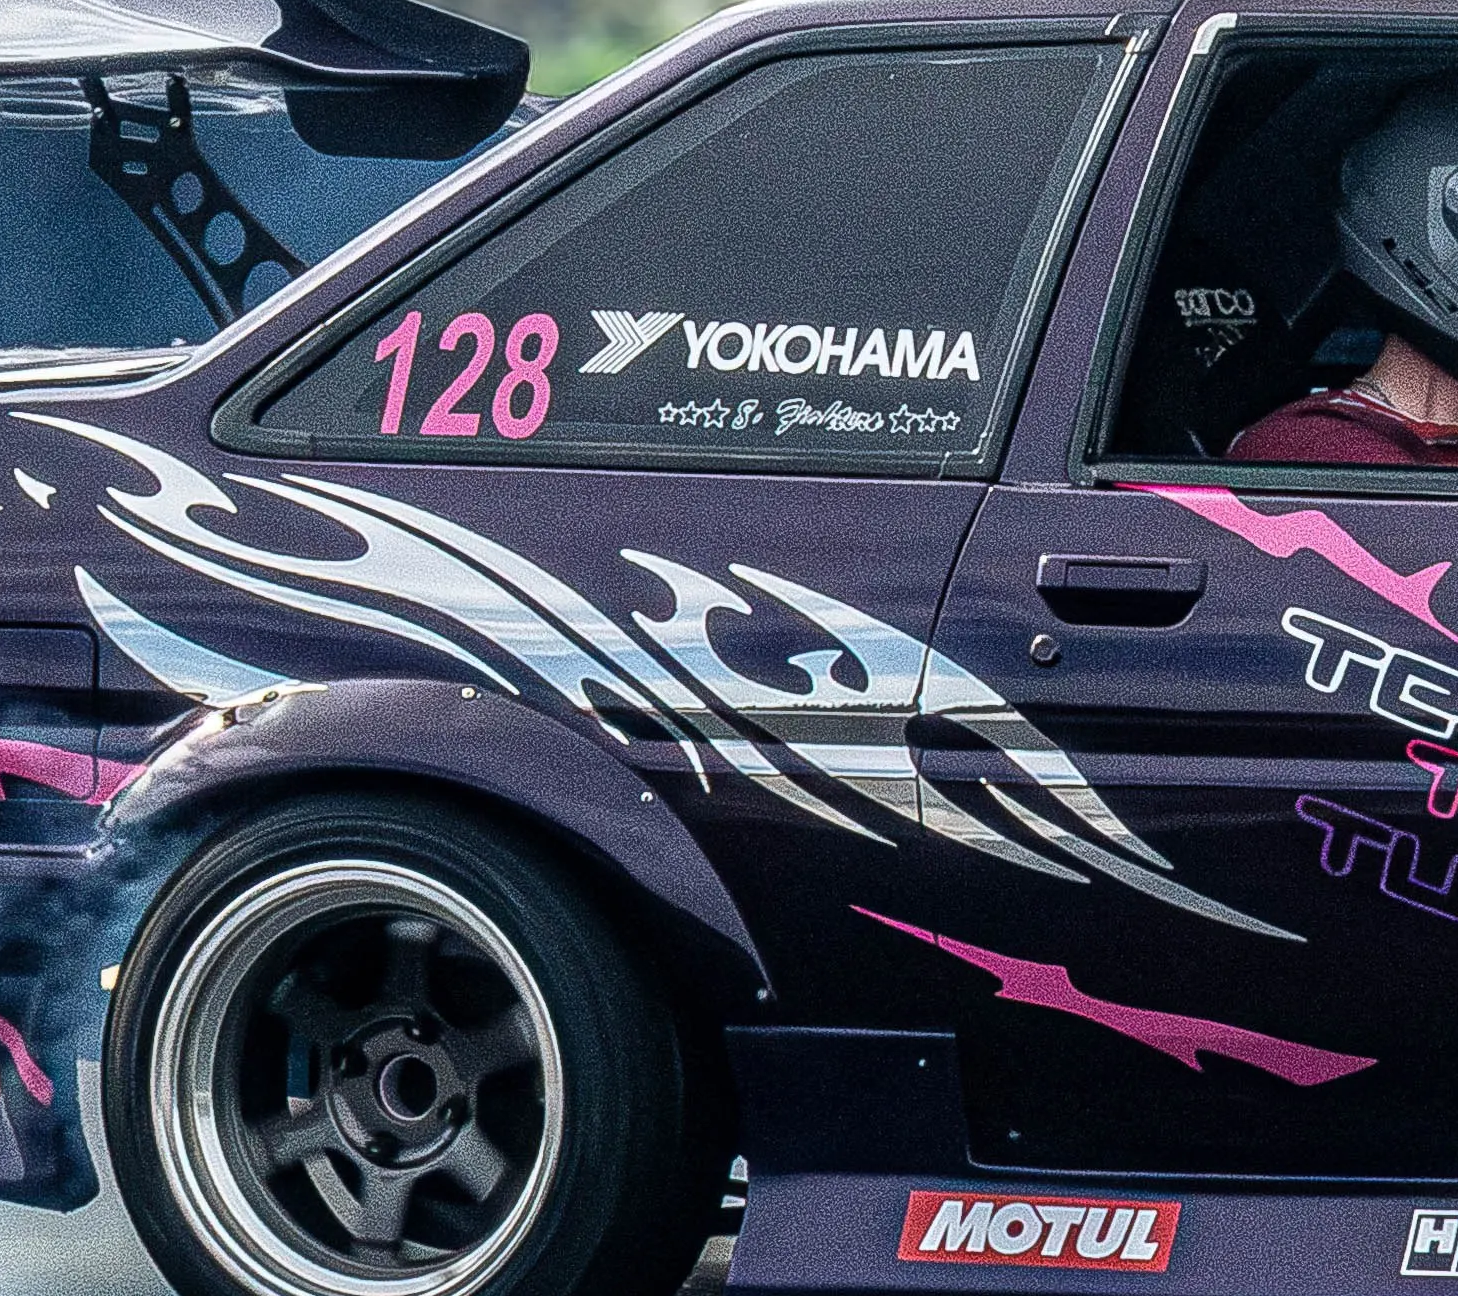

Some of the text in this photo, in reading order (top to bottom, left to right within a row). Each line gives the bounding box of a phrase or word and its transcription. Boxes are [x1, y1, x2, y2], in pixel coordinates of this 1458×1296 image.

[373, 309, 560, 440] 128
[682, 320, 980, 382] YOKOHAMA
[918, 1200, 1159, 1261] MOTUL
